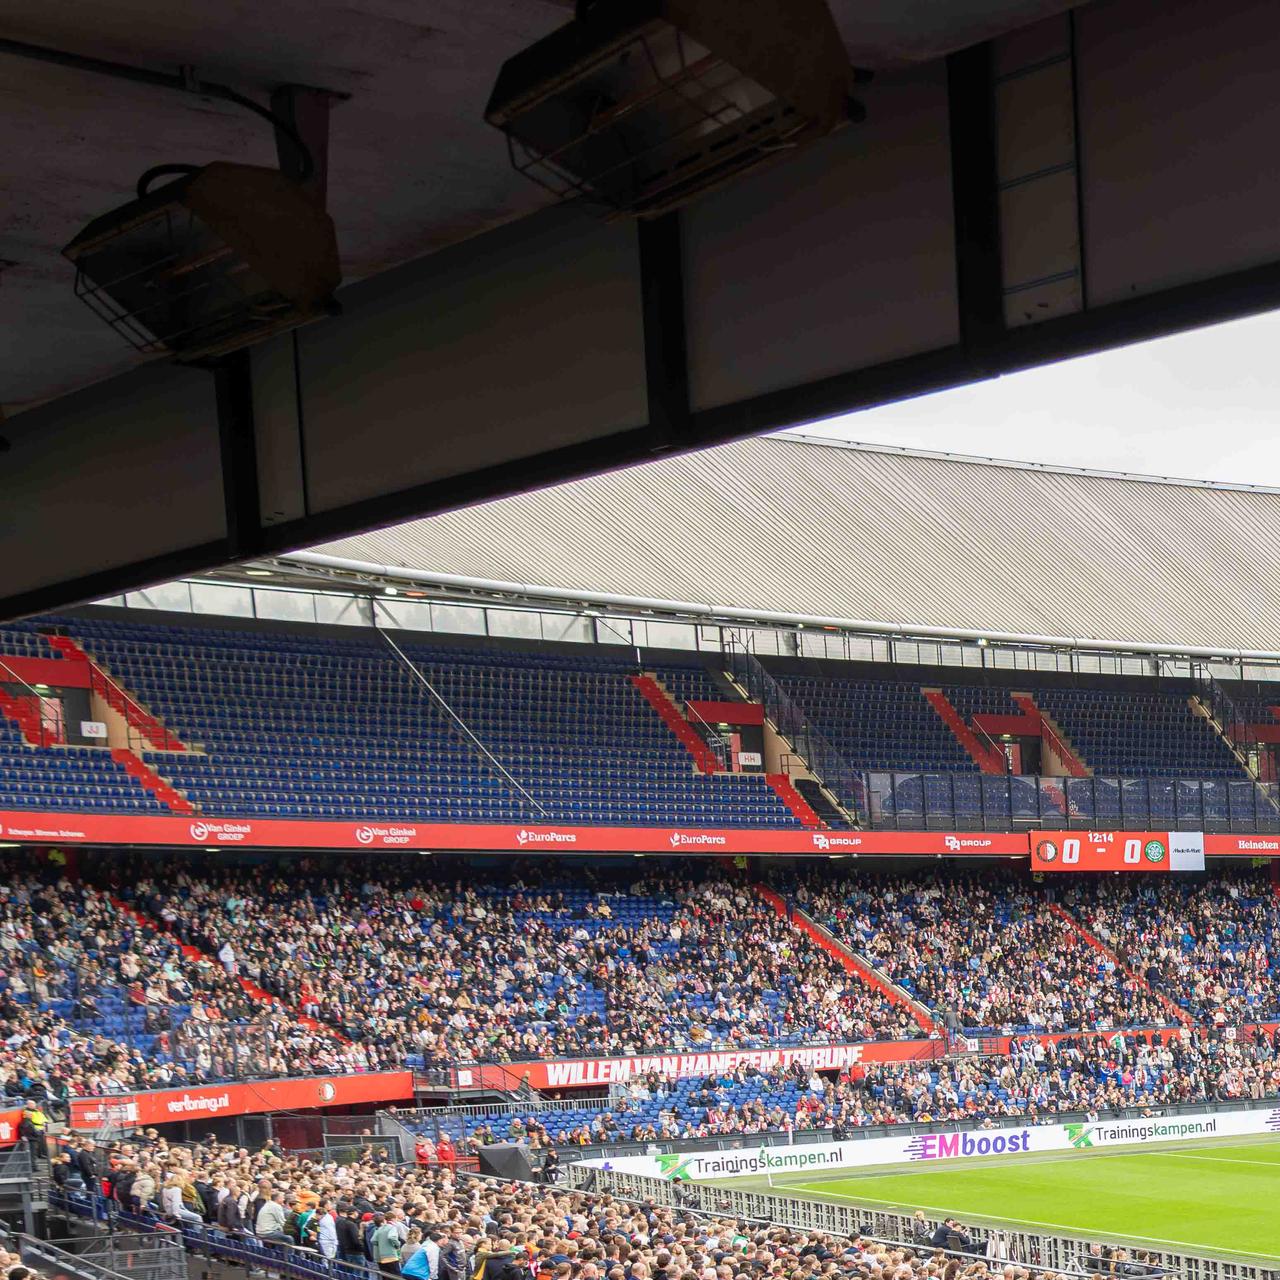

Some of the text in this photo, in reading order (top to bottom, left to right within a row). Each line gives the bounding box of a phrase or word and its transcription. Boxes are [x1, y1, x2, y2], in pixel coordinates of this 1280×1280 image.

[204, 824, 250, 834] Van Ginkel
[372, 828, 416, 838] Van Ginkel
[528, 832, 576, 842] EuroParcs
[681, 835, 725, 844] EuroParcs
[1088, 833, 1113, 842] 12:14
[1238, 840, 1278, 849] Heineken
[1062, 839, 1080, 863] 0
[1124, 840, 1141, 863] 0
[546, 1058, 630, 1086] WILLEM
[1096, 1118, 1216, 1140] Trainingskampen.nl
[920, 1131, 1030, 1158] EMboost
[695, 1148, 843, 1173] Trainingskampen.nl
